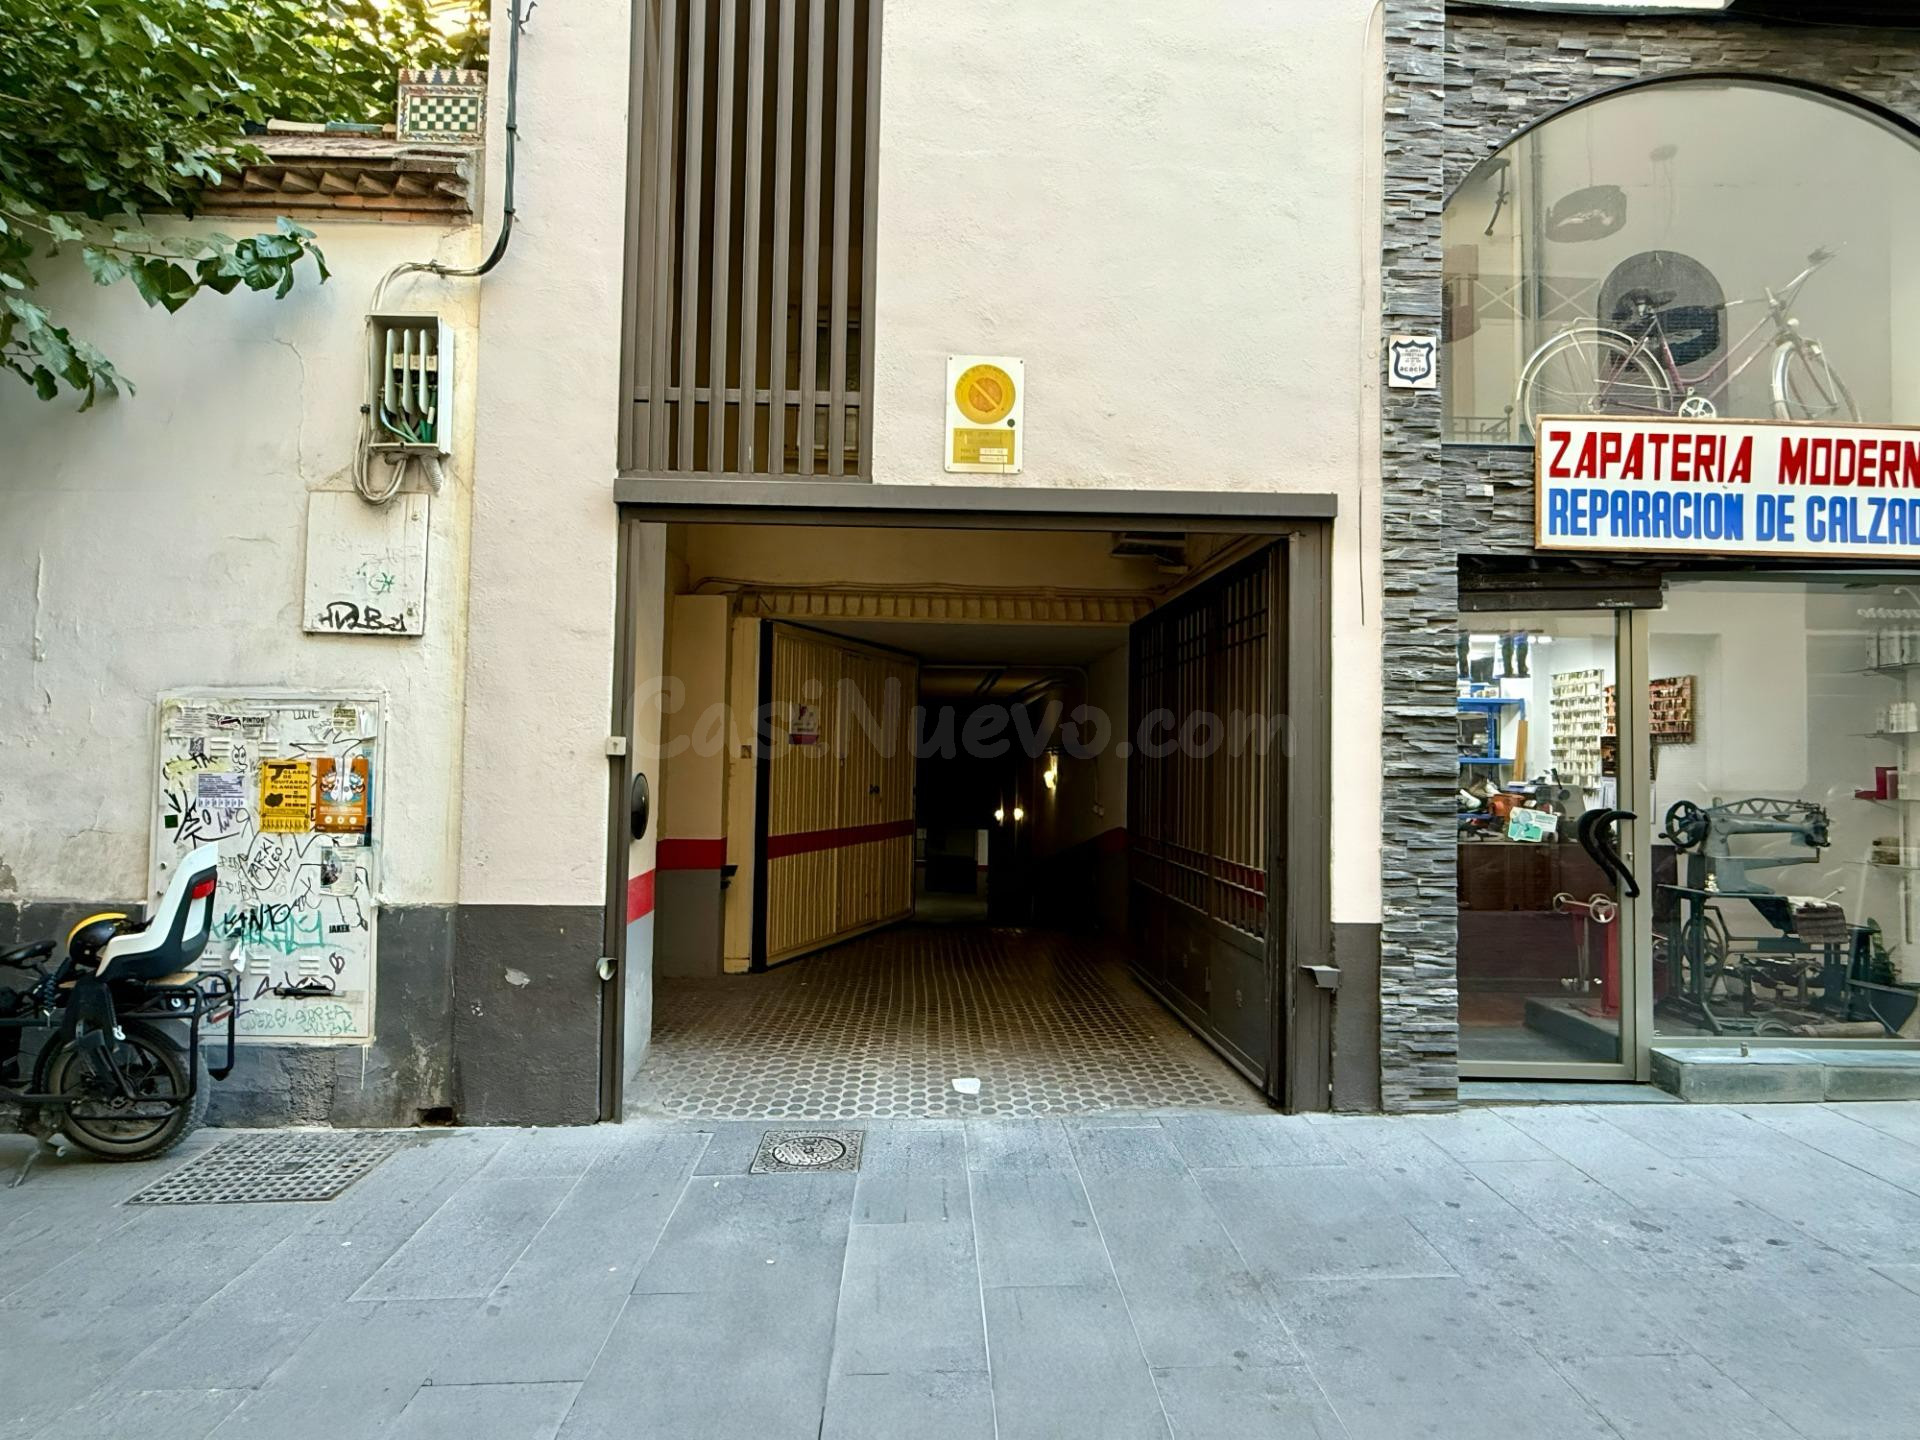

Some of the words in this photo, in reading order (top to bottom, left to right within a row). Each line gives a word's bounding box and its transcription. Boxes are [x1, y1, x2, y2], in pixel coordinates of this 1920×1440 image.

[1549, 431, 1753, 483] ZAPATERIA
[1549, 488, 1744, 541] REPARACION
[1756, 494, 1795, 542] DE
